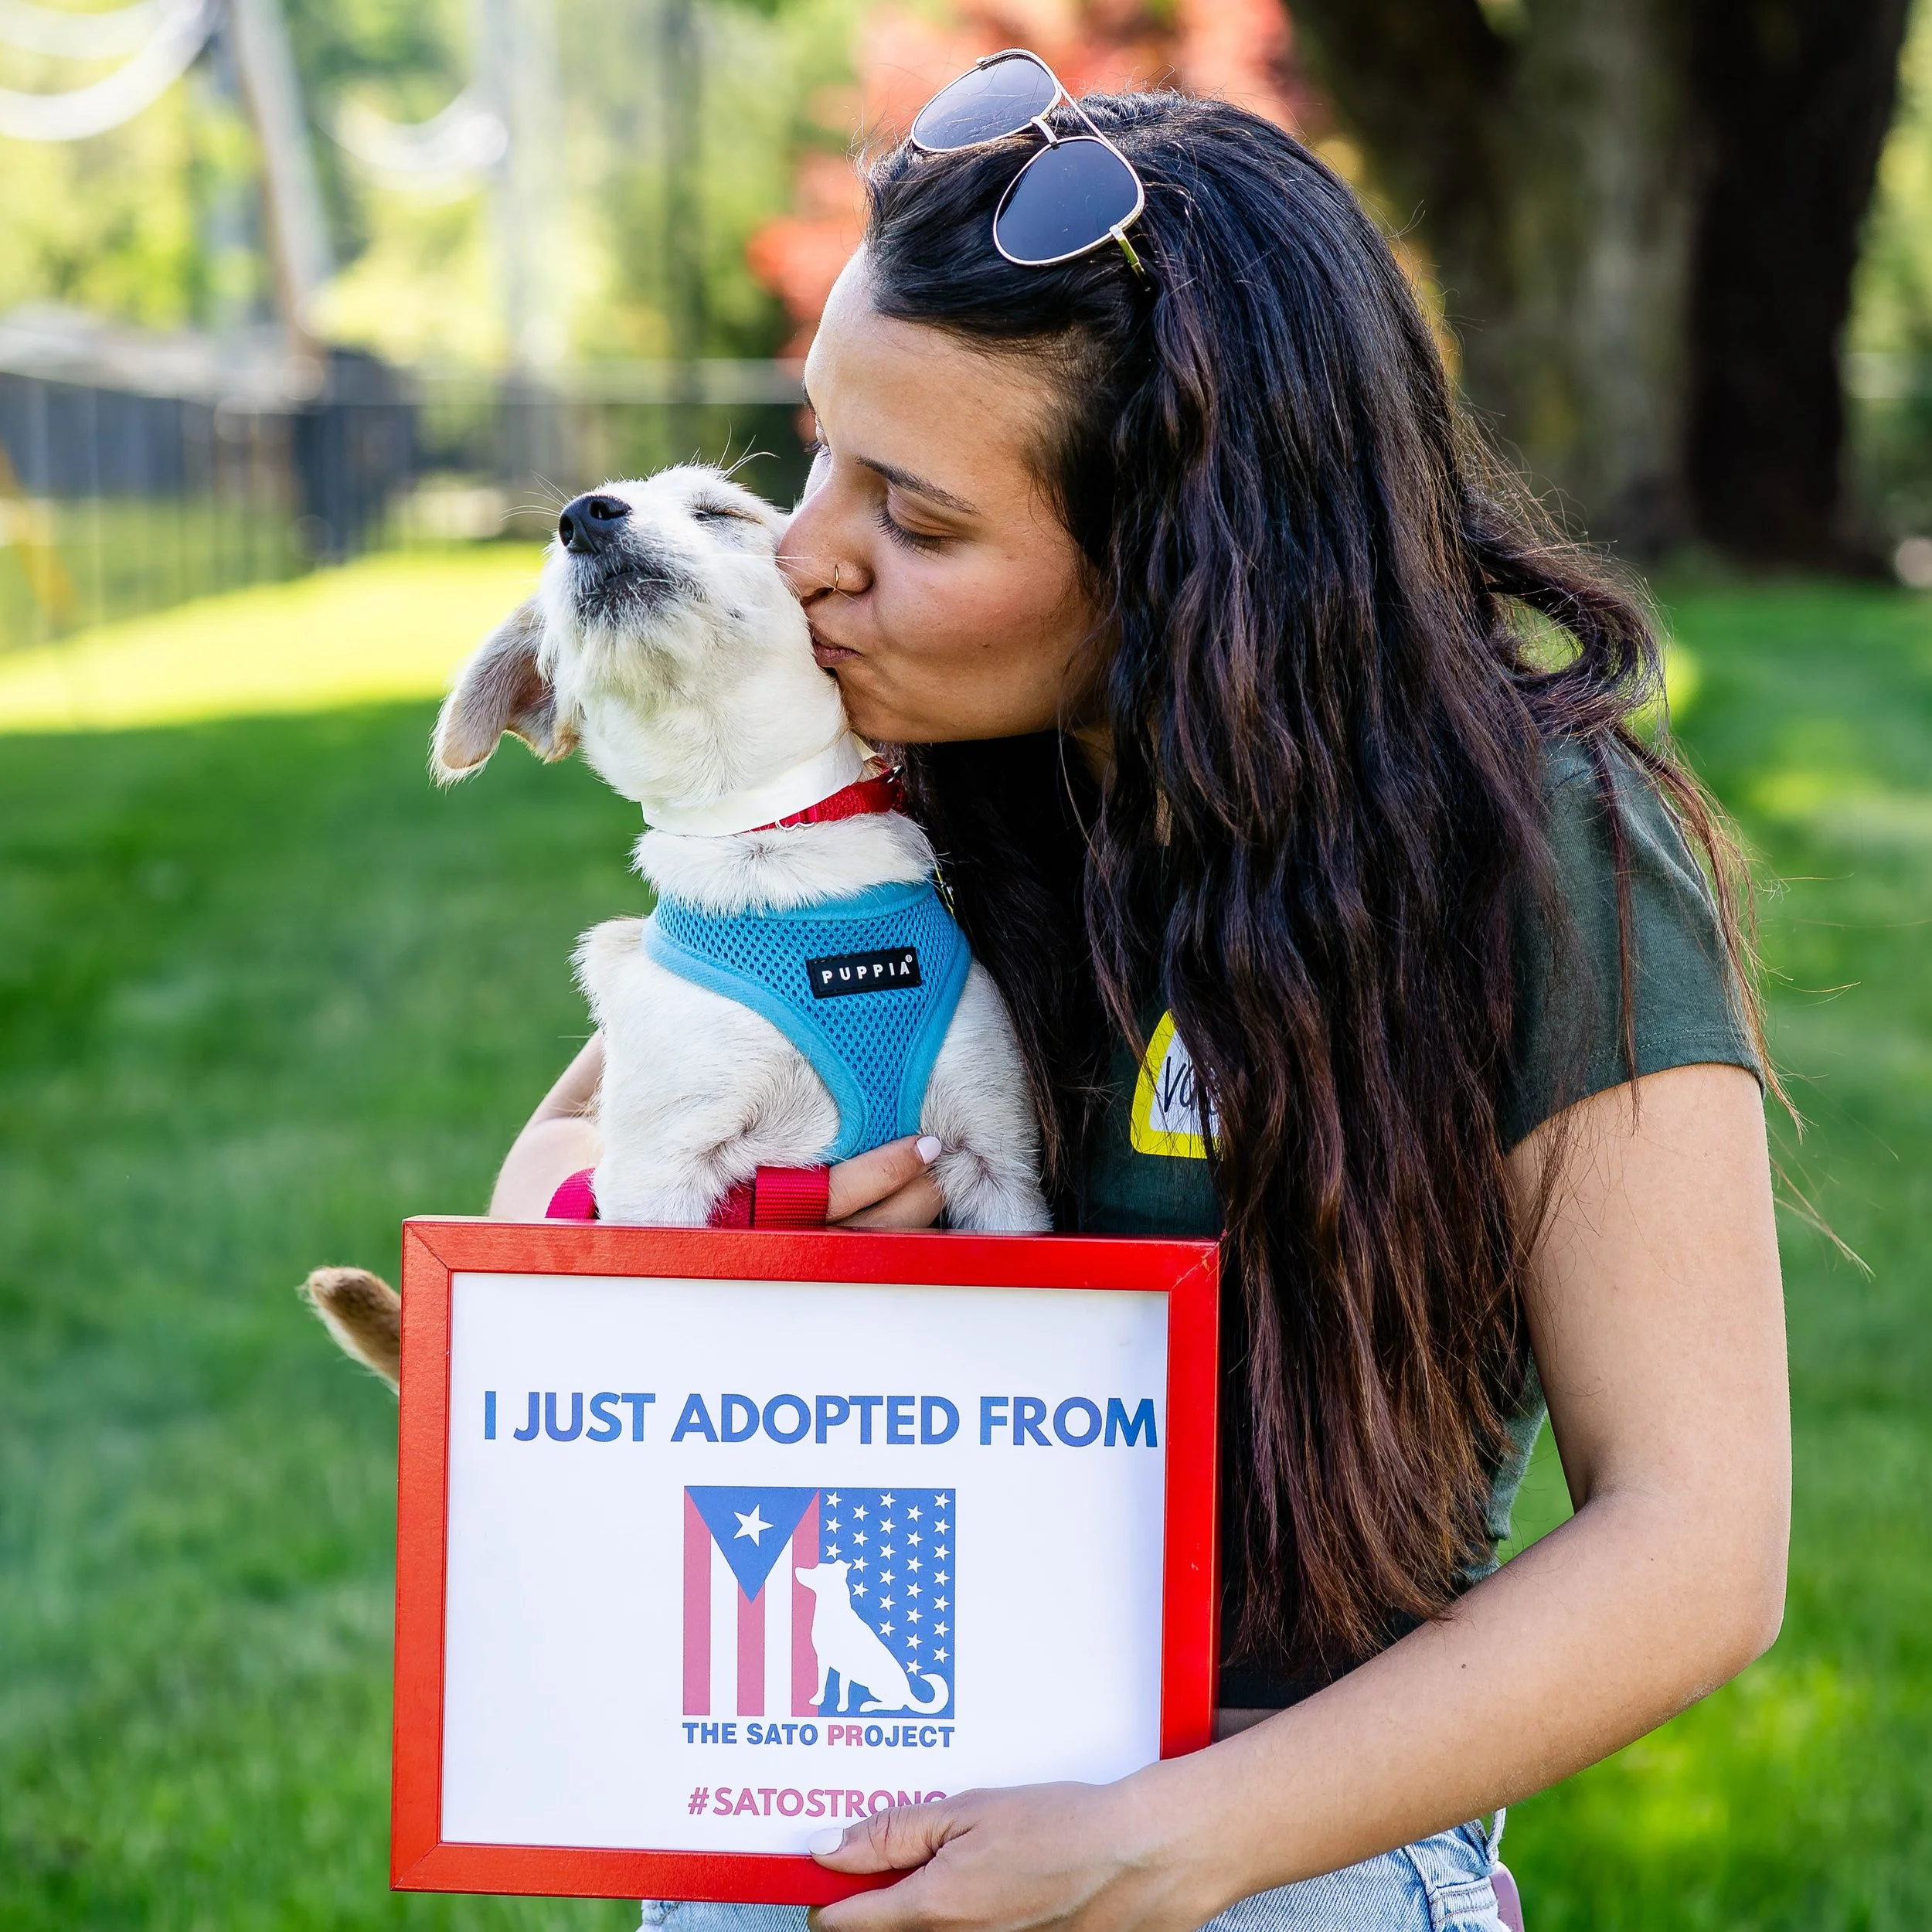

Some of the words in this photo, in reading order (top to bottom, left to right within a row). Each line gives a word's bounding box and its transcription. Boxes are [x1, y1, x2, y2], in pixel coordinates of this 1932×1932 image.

[484, 1390, 497, 1440] I
[513, 1391, 656, 1443] JUST
[670, 1393, 960, 1445] ADOPTED
[979, 1396, 1158, 1448] FROM
[682, 1722, 737, 1744] THE
[747, 1723, 818, 1746] SATO
[828, 1724, 955, 1748] PROJECT
